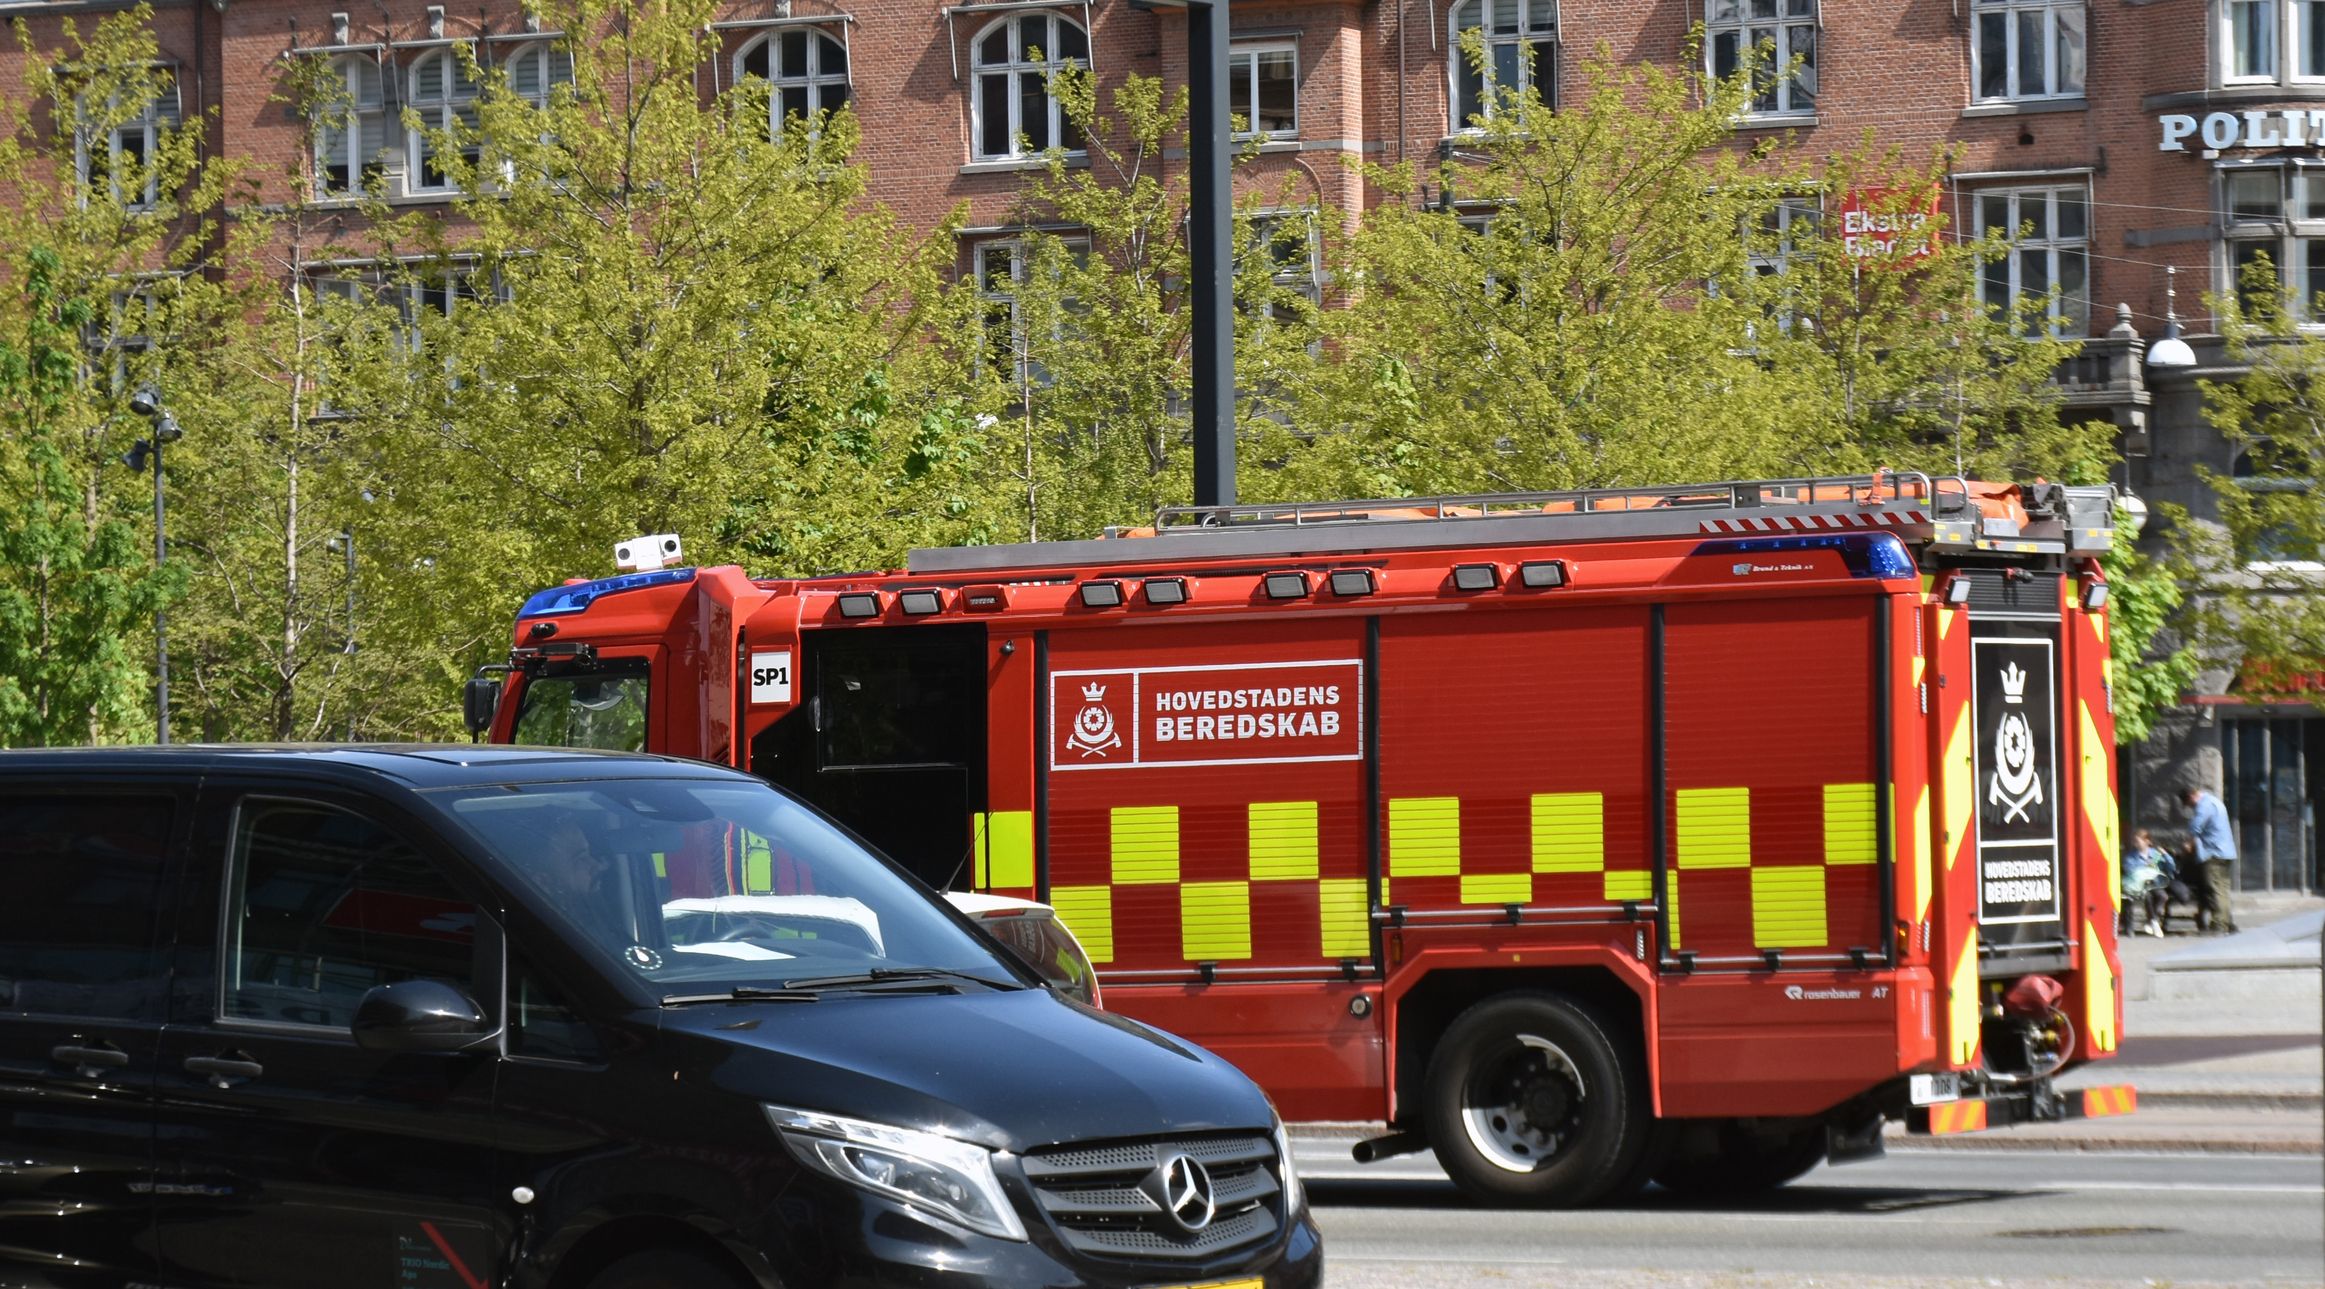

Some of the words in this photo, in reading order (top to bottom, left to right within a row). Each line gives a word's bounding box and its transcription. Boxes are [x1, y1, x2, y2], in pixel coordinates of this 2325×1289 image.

[753, 667, 789, 686] SP1
[1156, 685, 1340, 712] HOVEDSTADENS
[1156, 711, 1340, 742] BEREDSKAB
[1984, 860, 2051, 879] HOVEDSTADENS
[1985, 879, 2052, 904] BEREDSKAB
[1804, 987, 1861, 1000] rosenbauer
[1872, 986, 1889, 999] AT
